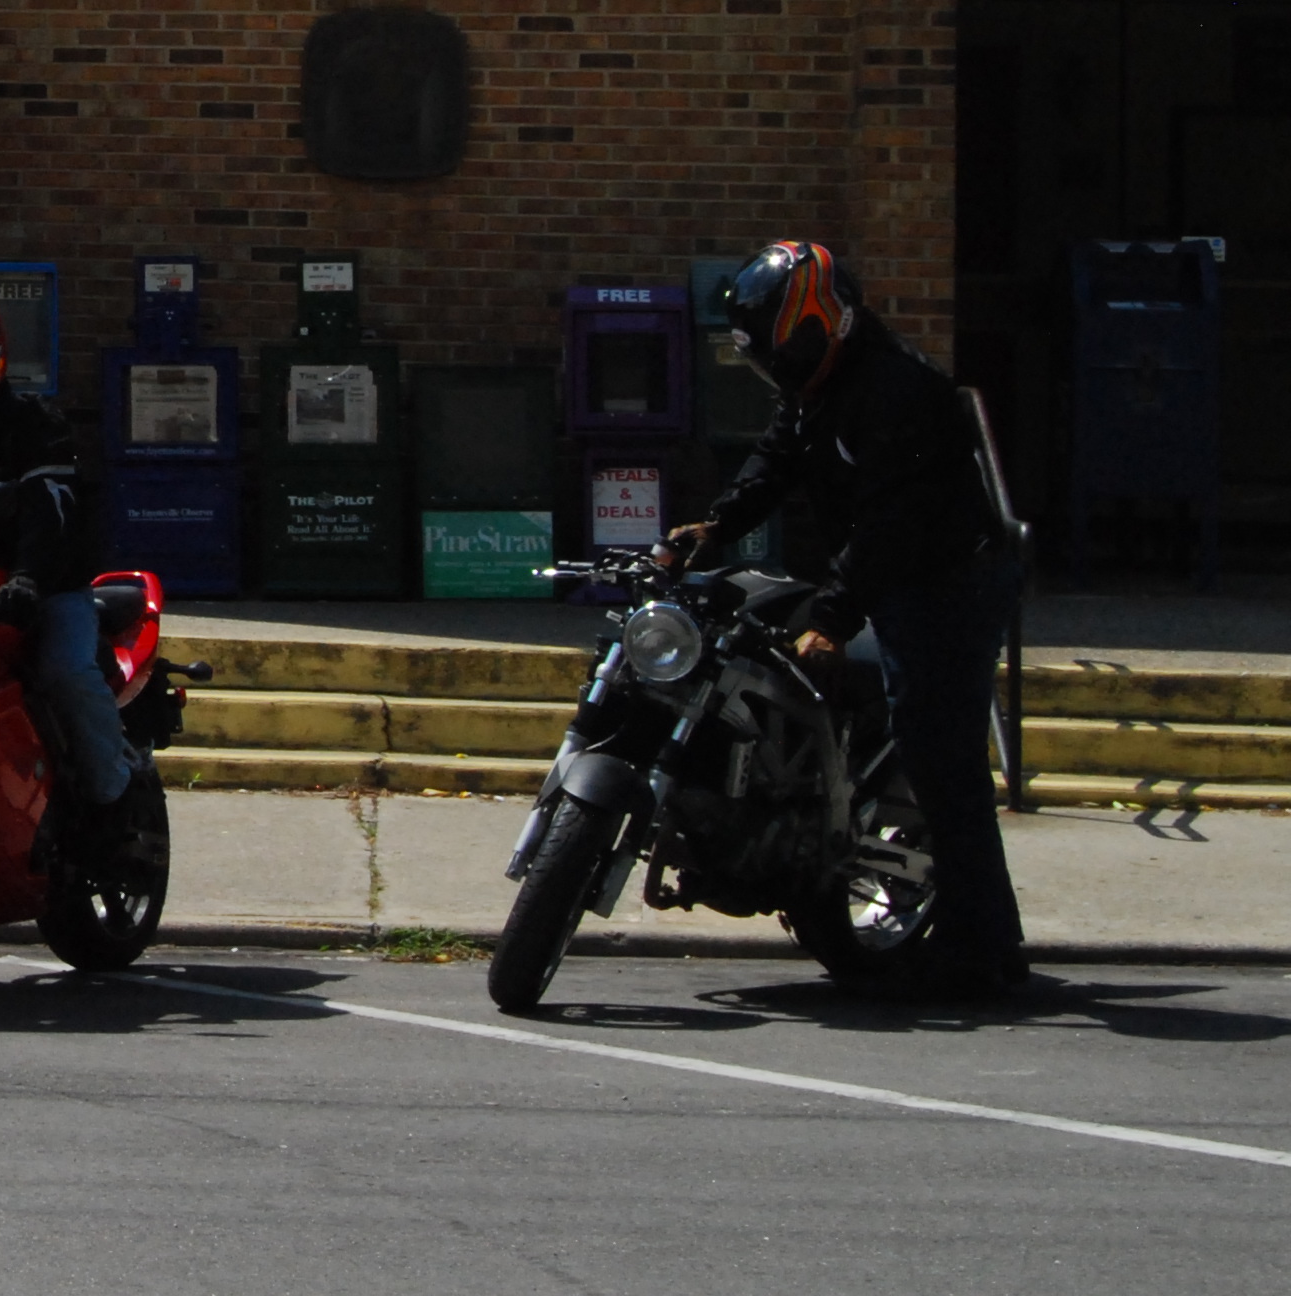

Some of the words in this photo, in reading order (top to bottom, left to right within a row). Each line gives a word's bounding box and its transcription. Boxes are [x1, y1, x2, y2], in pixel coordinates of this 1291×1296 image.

[597, 289, 651, 303] FREE
[594, 470, 658, 482] STEALS
[620, 488, 632, 500] &
[287, 495, 316, 506] THE
[334, 495, 375, 506] PILOT
[597, 506, 656, 518] DEALS
[424, 526, 549, 553] PineStraw
